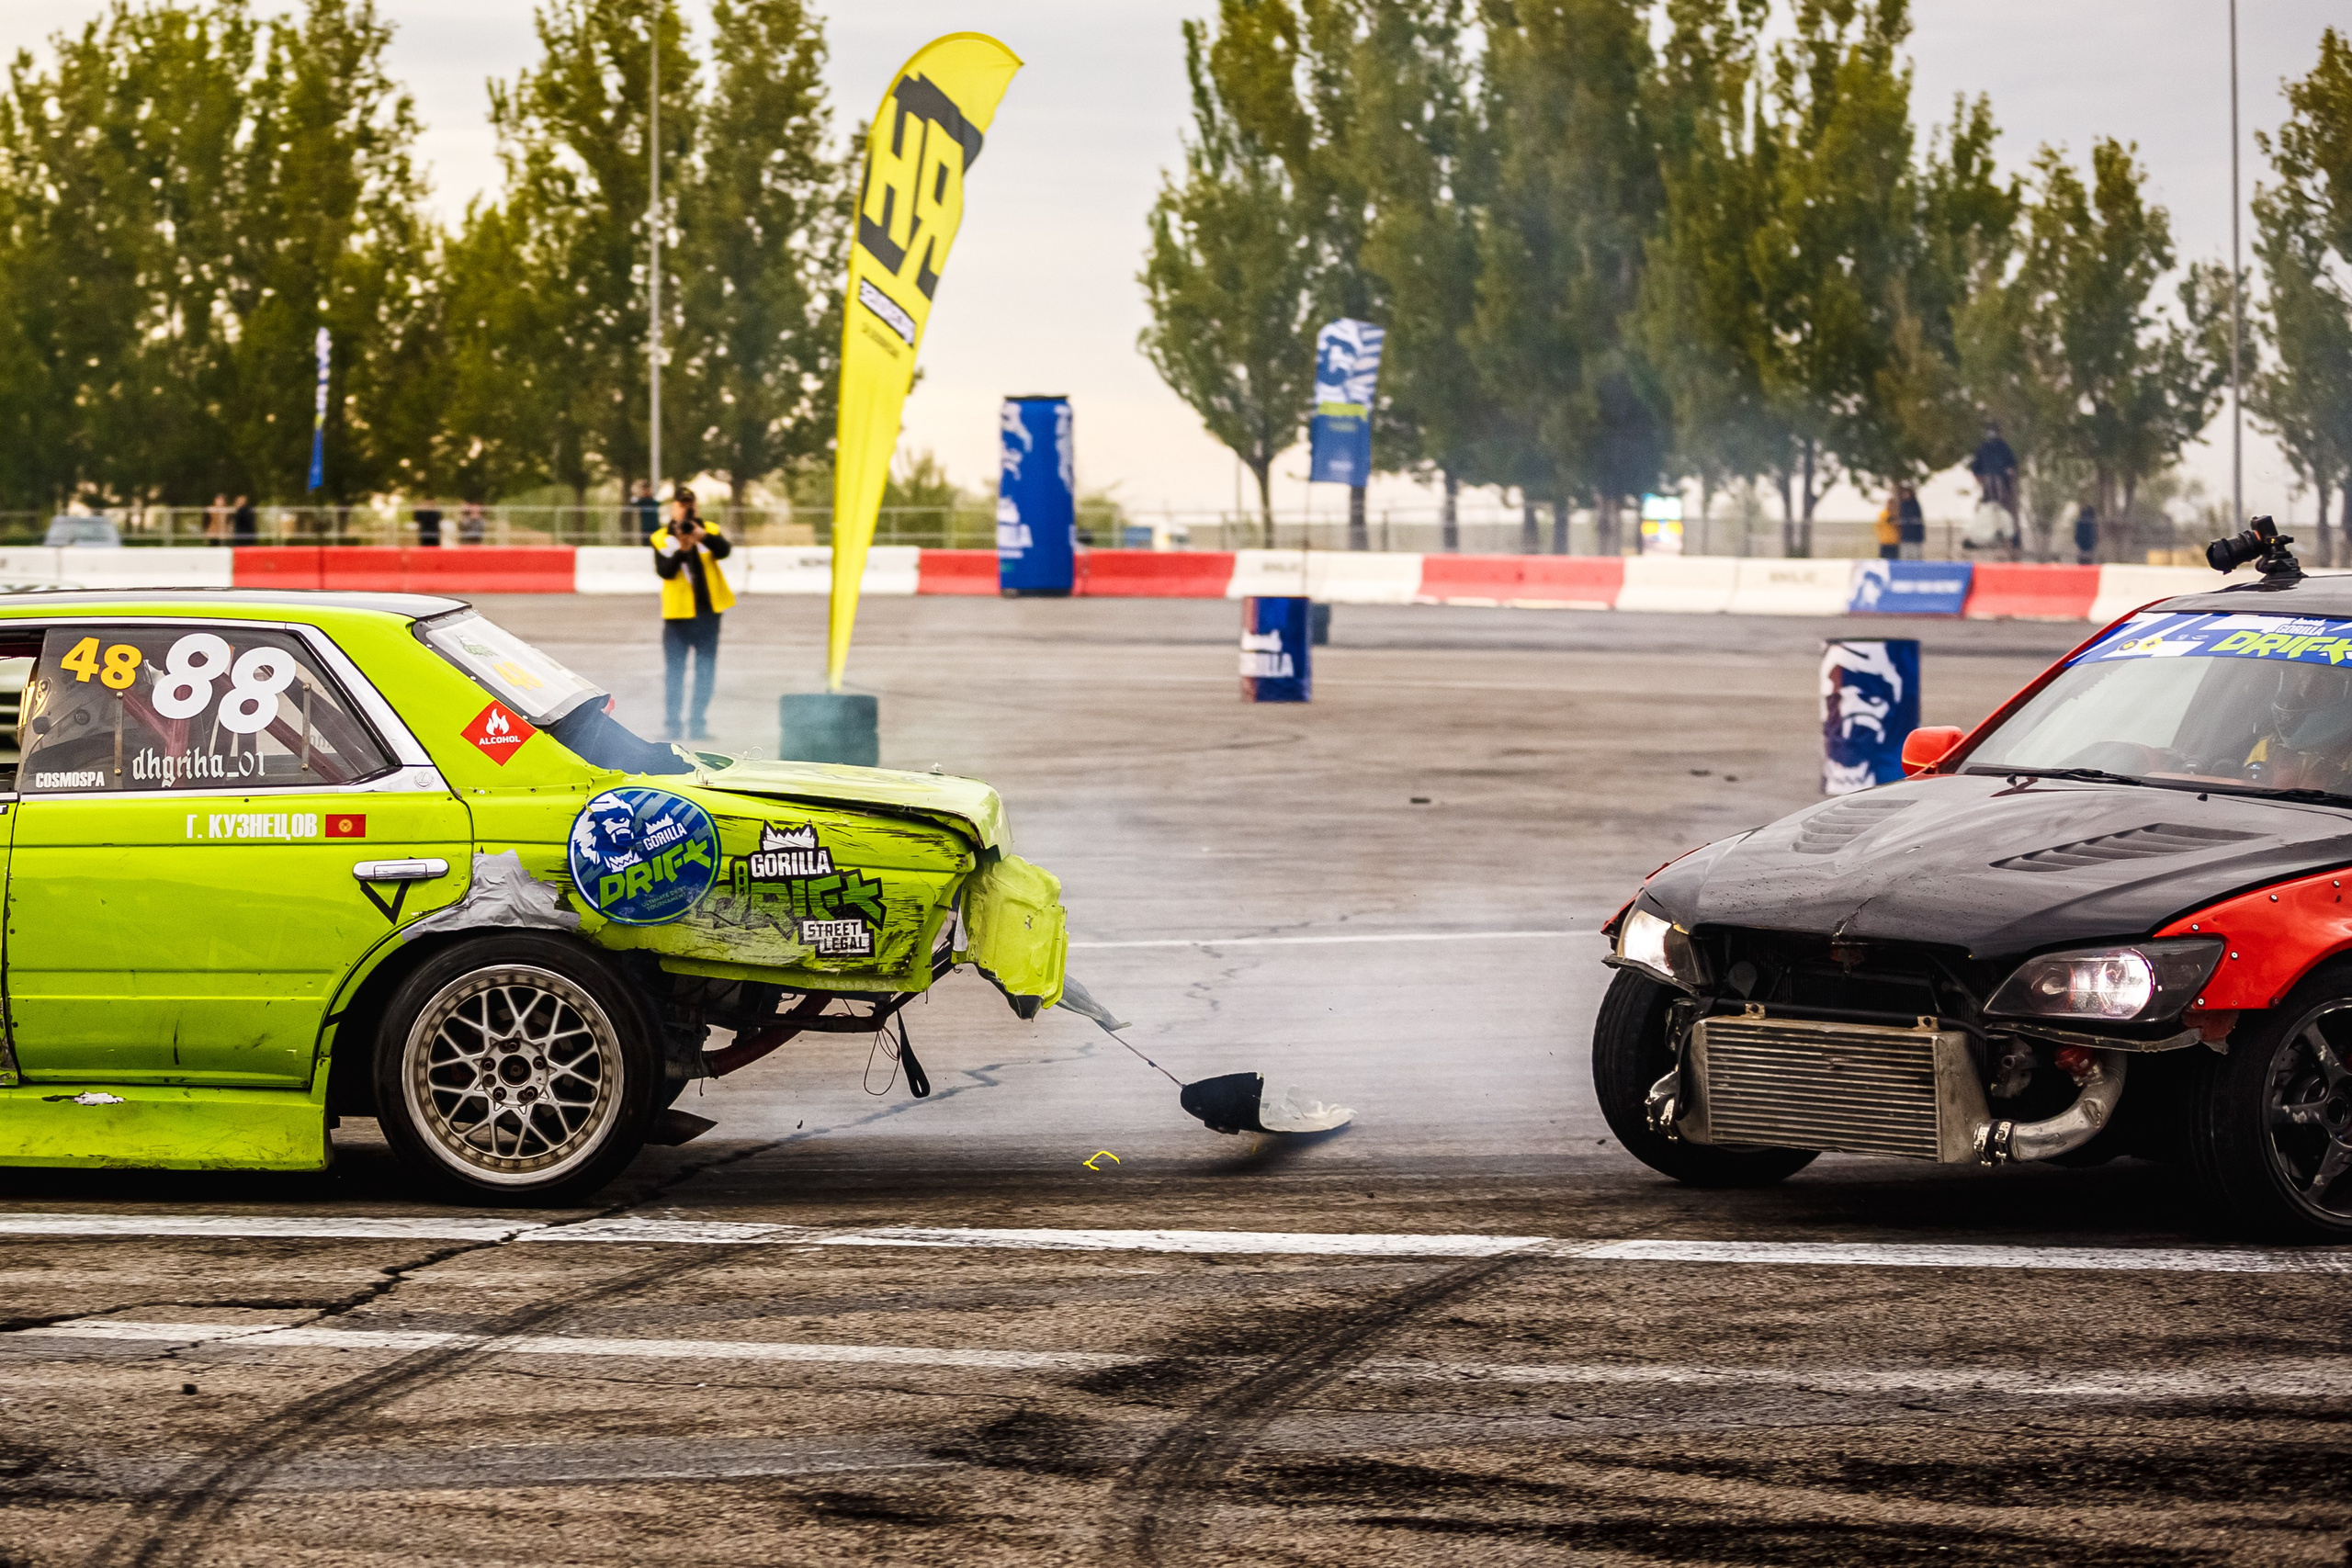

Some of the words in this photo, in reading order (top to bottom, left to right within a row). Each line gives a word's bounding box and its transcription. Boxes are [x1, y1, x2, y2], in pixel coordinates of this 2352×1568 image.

[2275, 624, 2326, 637] GORILLA
[61, 637, 142, 689] 48
[152, 633, 297, 734] 88
[479, 735, 521, 746] ALCOHOL
[132, 747, 266, 788] dhgriha_01
[35, 771, 105, 788] COSMOSPA
[187, 814, 202, 839] Г.
[209, 813, 317, 840] КУЗНЕЦОВ
[643, 822, 687, 851] GORILLA
[599, 839, 711, 909] DRIFT
[751, 851, 831, 878] GORILLA
[640, 891, 670, 908] ULTIMATE
[645, 892, 687, 912] TOURNAMENT
[808, 921, 859, 937] STREET
[823, 936, 865, 952] LEGAL
